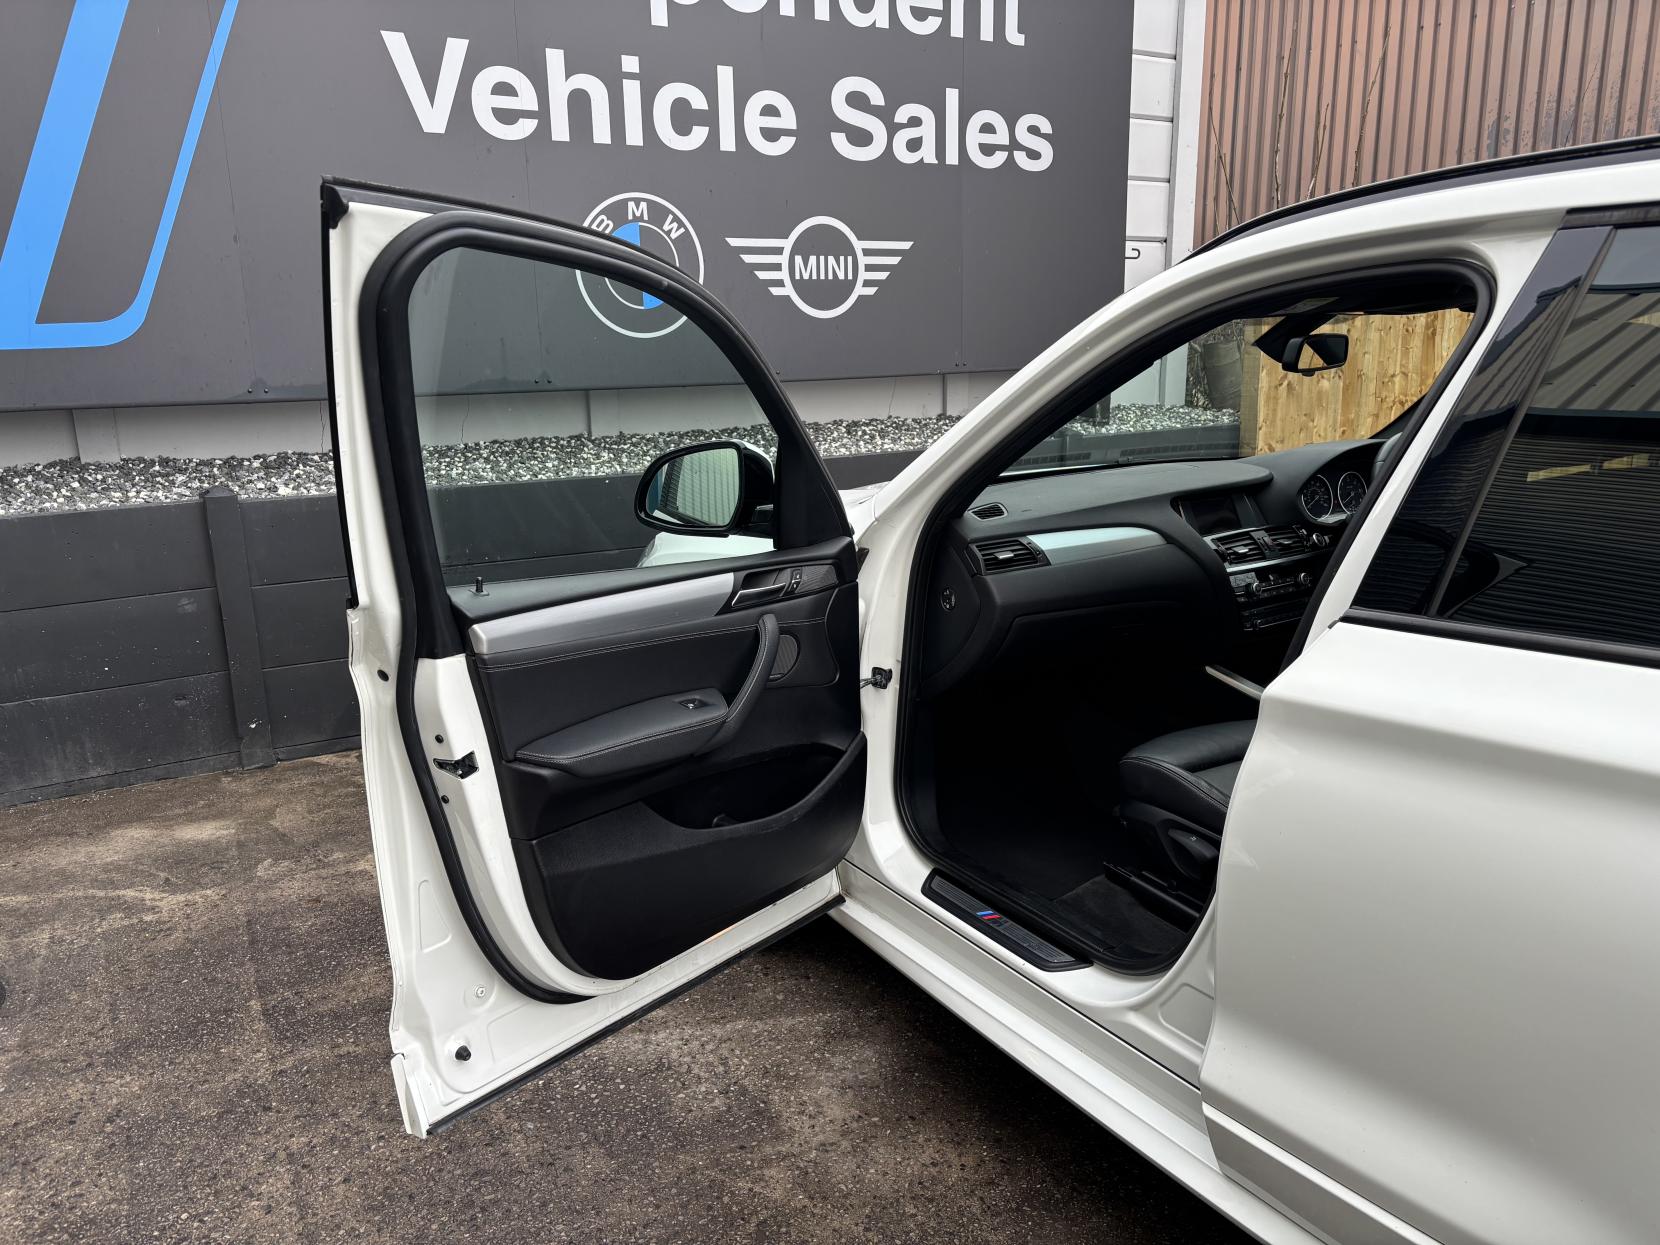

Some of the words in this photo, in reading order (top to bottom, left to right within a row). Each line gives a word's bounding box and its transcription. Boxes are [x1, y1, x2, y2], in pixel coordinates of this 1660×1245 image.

[380, 30, 798, 157] Vehicle
[830, 76, 1054, 172] Sales
[590, 200, 686, 240] BMW
[794, 254, 853, 280] MINI
